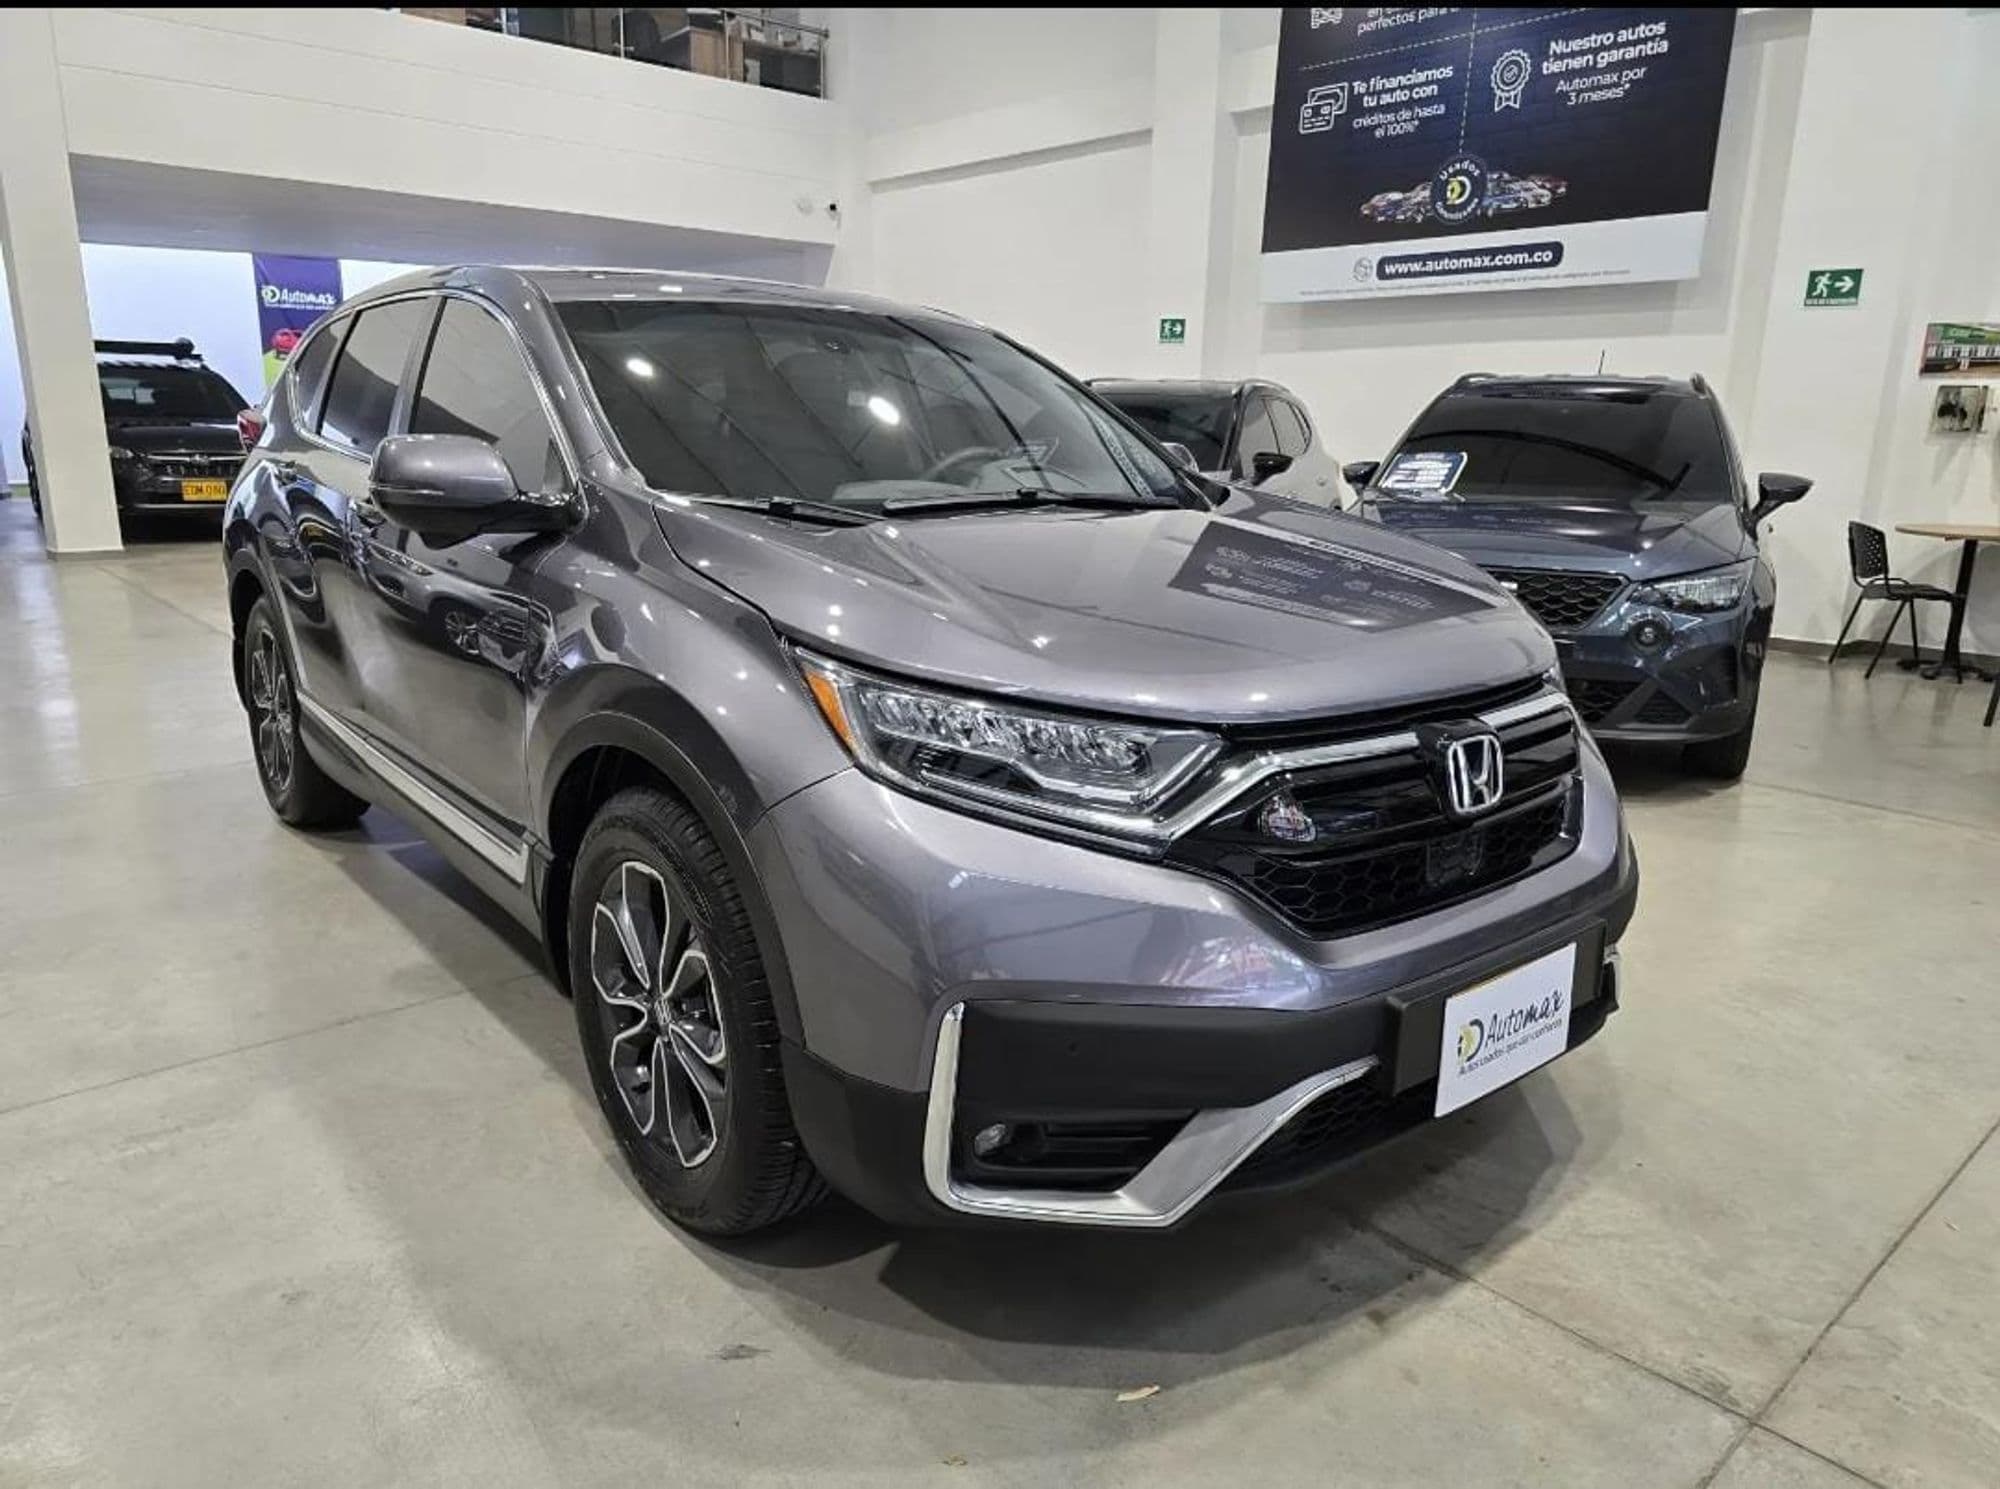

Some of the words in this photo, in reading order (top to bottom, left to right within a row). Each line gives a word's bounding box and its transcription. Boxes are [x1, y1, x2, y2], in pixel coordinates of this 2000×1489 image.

[1357, 12, 1416, 37] perfectos
[1549, 32, 1615, 55] Nuestro
[1617, 21, 1667, 42] autos
[1542, 53, 1594, 75] tienen
[1596, 37, 1669, 68] garantía
[1352, 81, 1368, 95] Te
[1369, 65, 1454, 92] financiamos
[1555, 72, 1620, 93] Automax
[1620, 67, 1648, 84] por
[1363, 95, 1377, 107] tu
[1379, 87, 1411, 105] auto
[1412, 84, 1439, 99] con
[1566, 92, 1577, 105] 3
[1396, 107, 1412, 121] de
[1413, 103, 1446, 118] hasta
[1374, 125, 1385, 138] el
[1384, 249, 1554, 276] www.automax.com.co
[281, 287, 337, 305] Automax
[1485, 989, 1565, 1048] Automax
